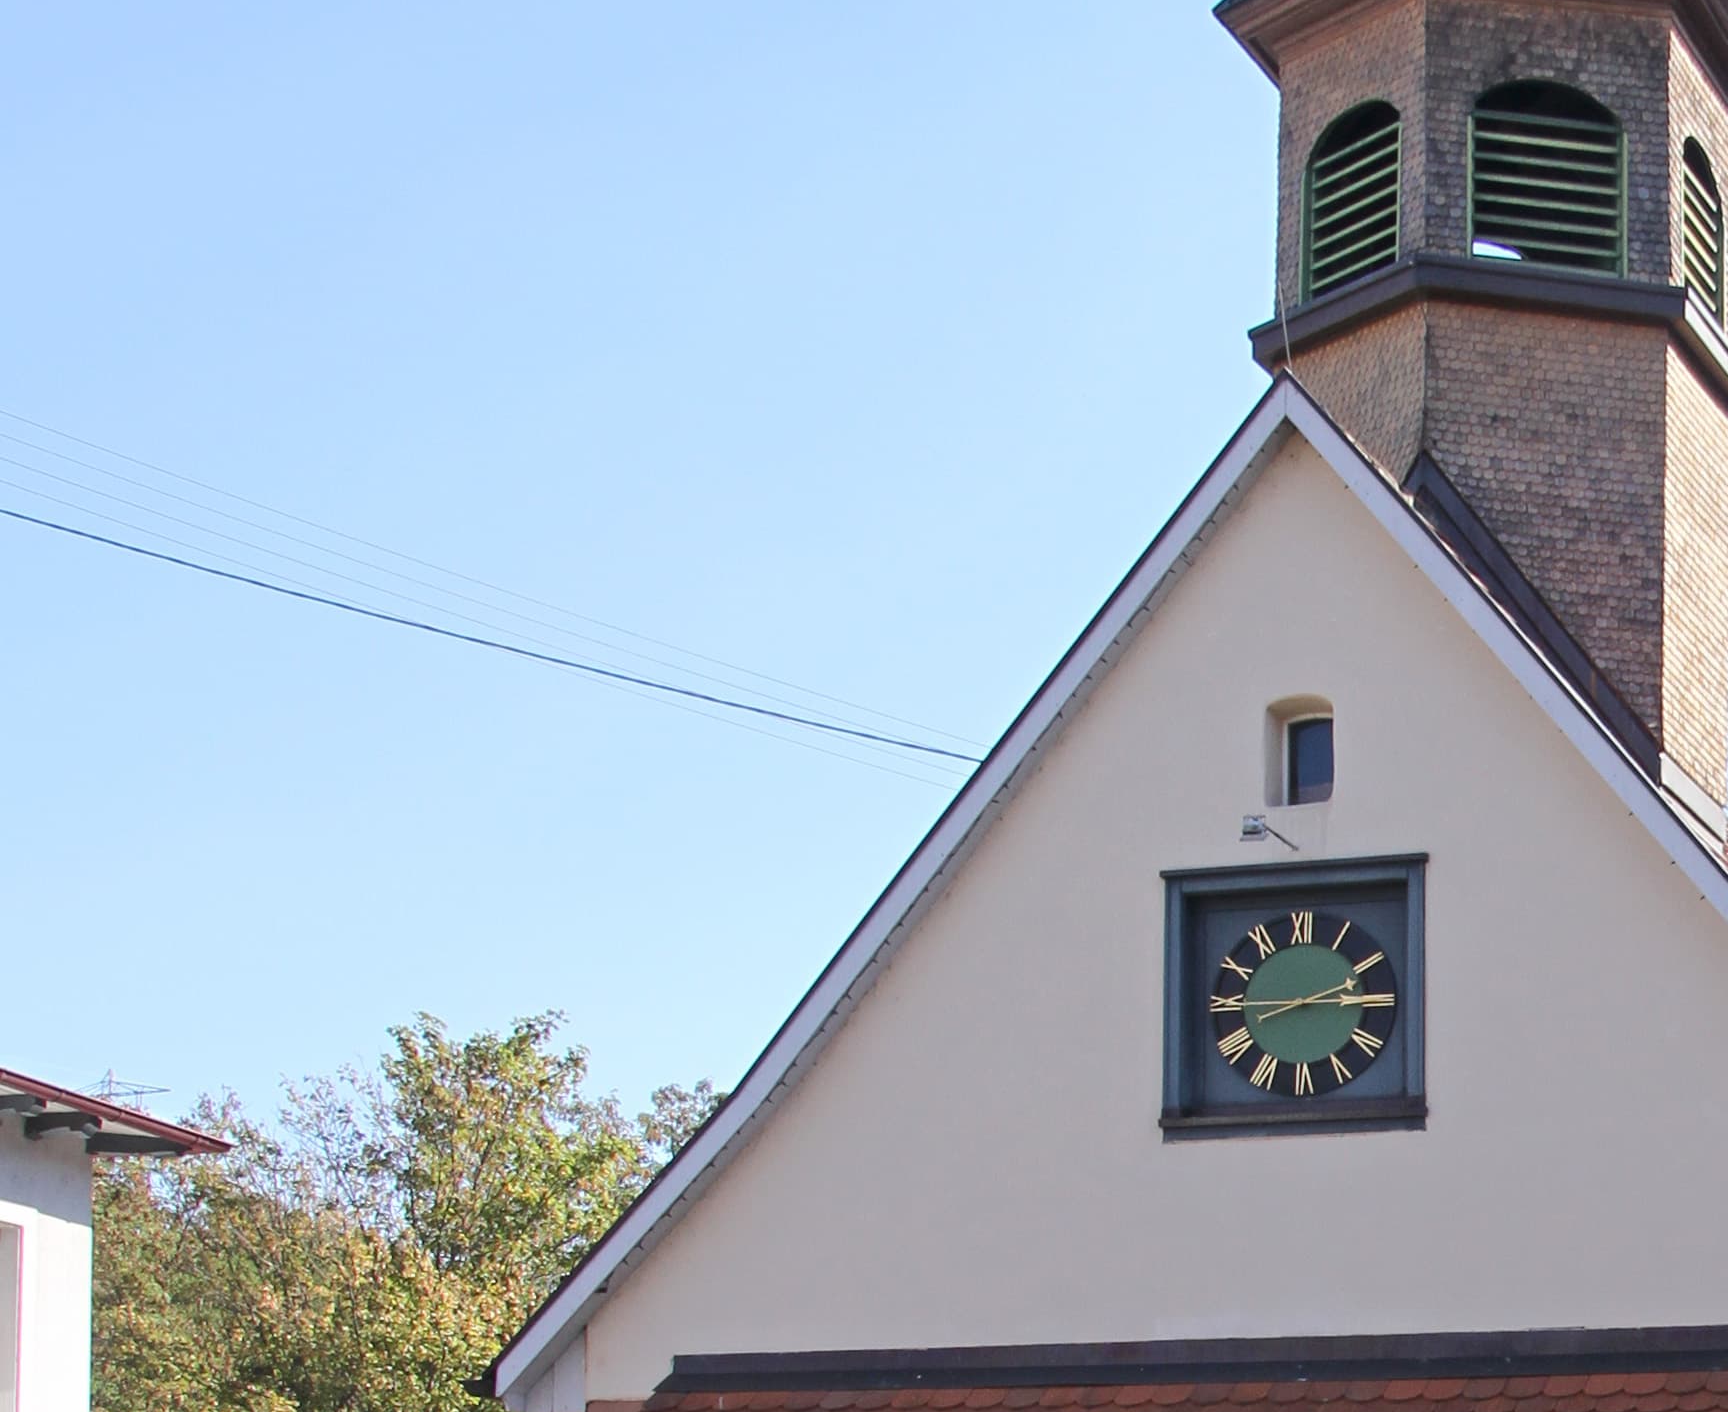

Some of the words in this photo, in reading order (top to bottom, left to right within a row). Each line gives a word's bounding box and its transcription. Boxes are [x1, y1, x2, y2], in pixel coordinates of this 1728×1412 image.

[1248, 924, 1276, 960] XI
[1291, 911, 1312, 945] XII
[1331, 920, 1351, 951] I
[1220, 956, 1253, 980] X
[1353, 951, 1385, 975] II
[1209, 993, 1245, 1013] IX
[1217, 1026, 1254, 1066] VIII
[1351, 1028, 1384, 1058] IV
[1250, 1053, 1278, 1091] VII
[1295, 1062, 1315, 1096] VI
[1329, 1052, 1353, 1085] V
